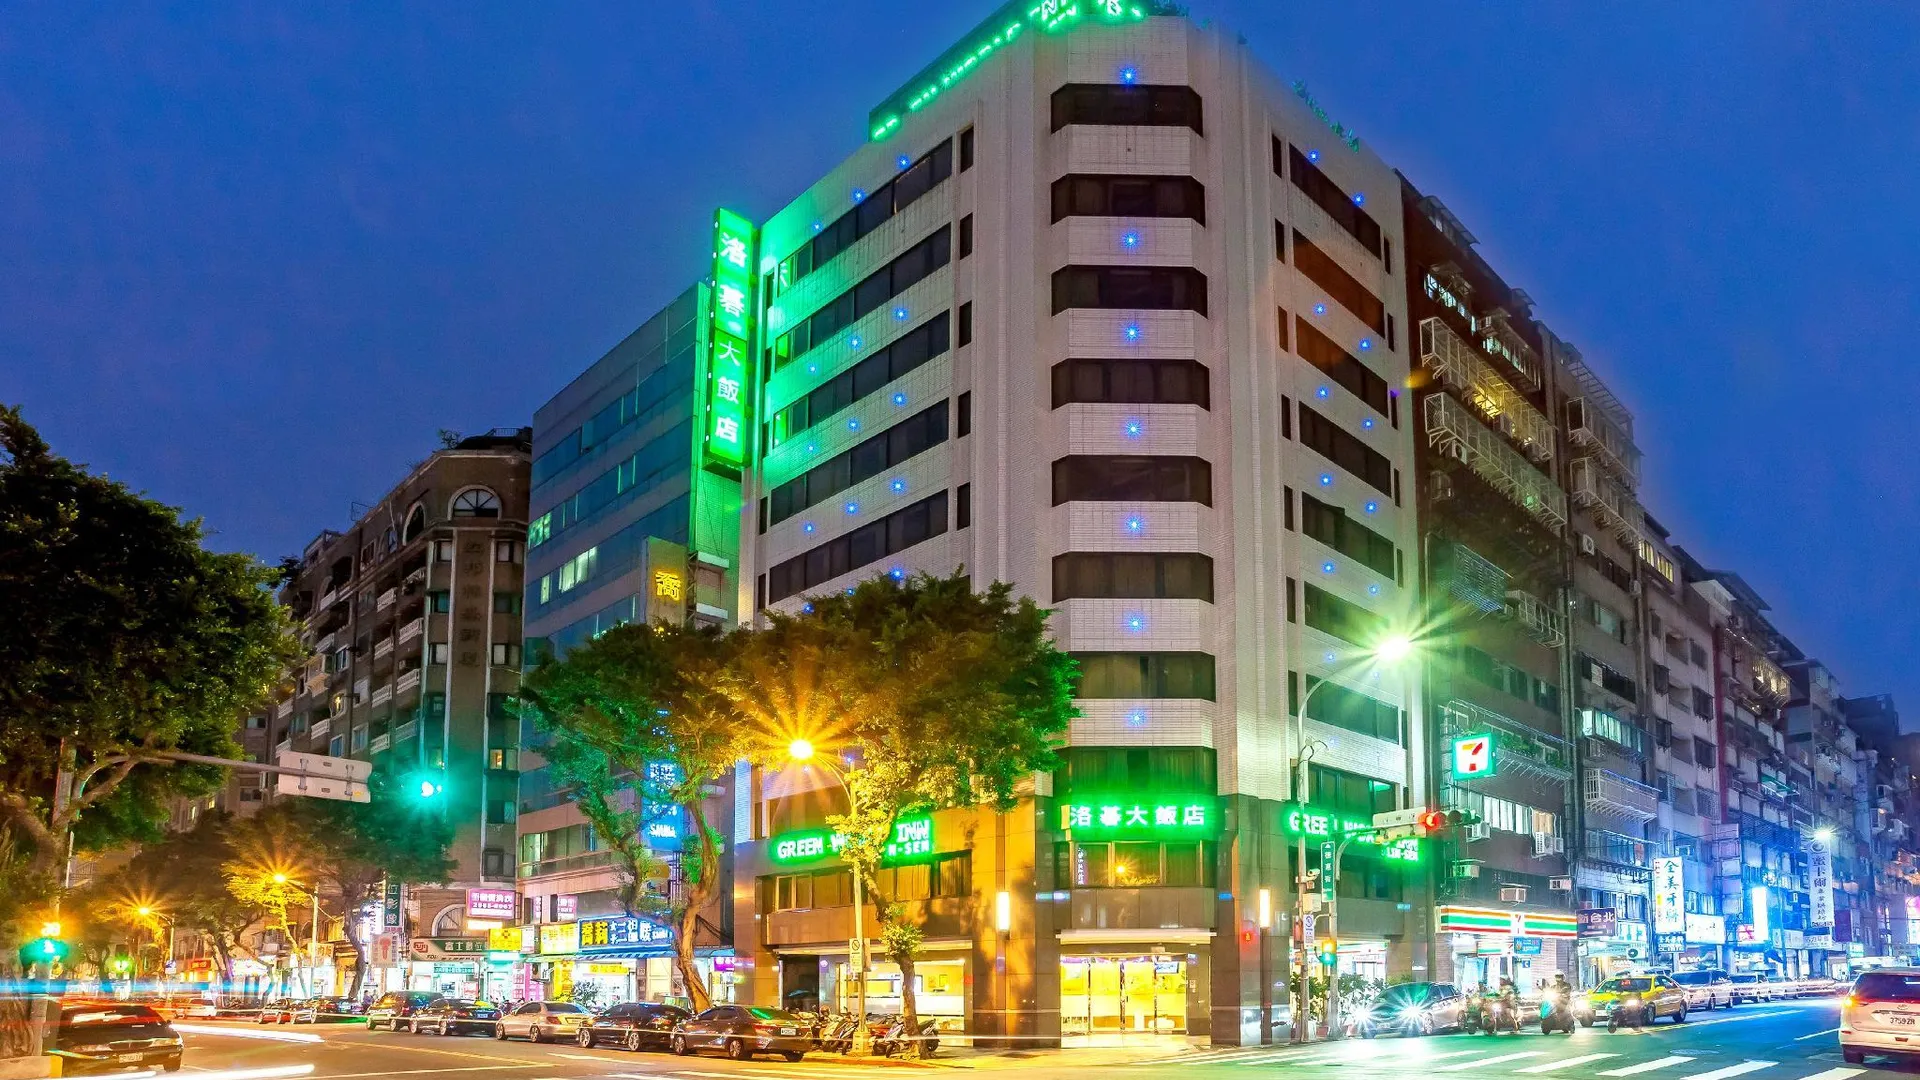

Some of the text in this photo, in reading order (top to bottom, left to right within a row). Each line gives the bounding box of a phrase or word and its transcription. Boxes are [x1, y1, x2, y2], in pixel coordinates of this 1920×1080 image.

[1289, 811, 1338, 835] GREE
[777, 836, 824, 859] GREEN
[896, 819, 930, 843] INN
[888, 840, 930, 856] N-SEN
